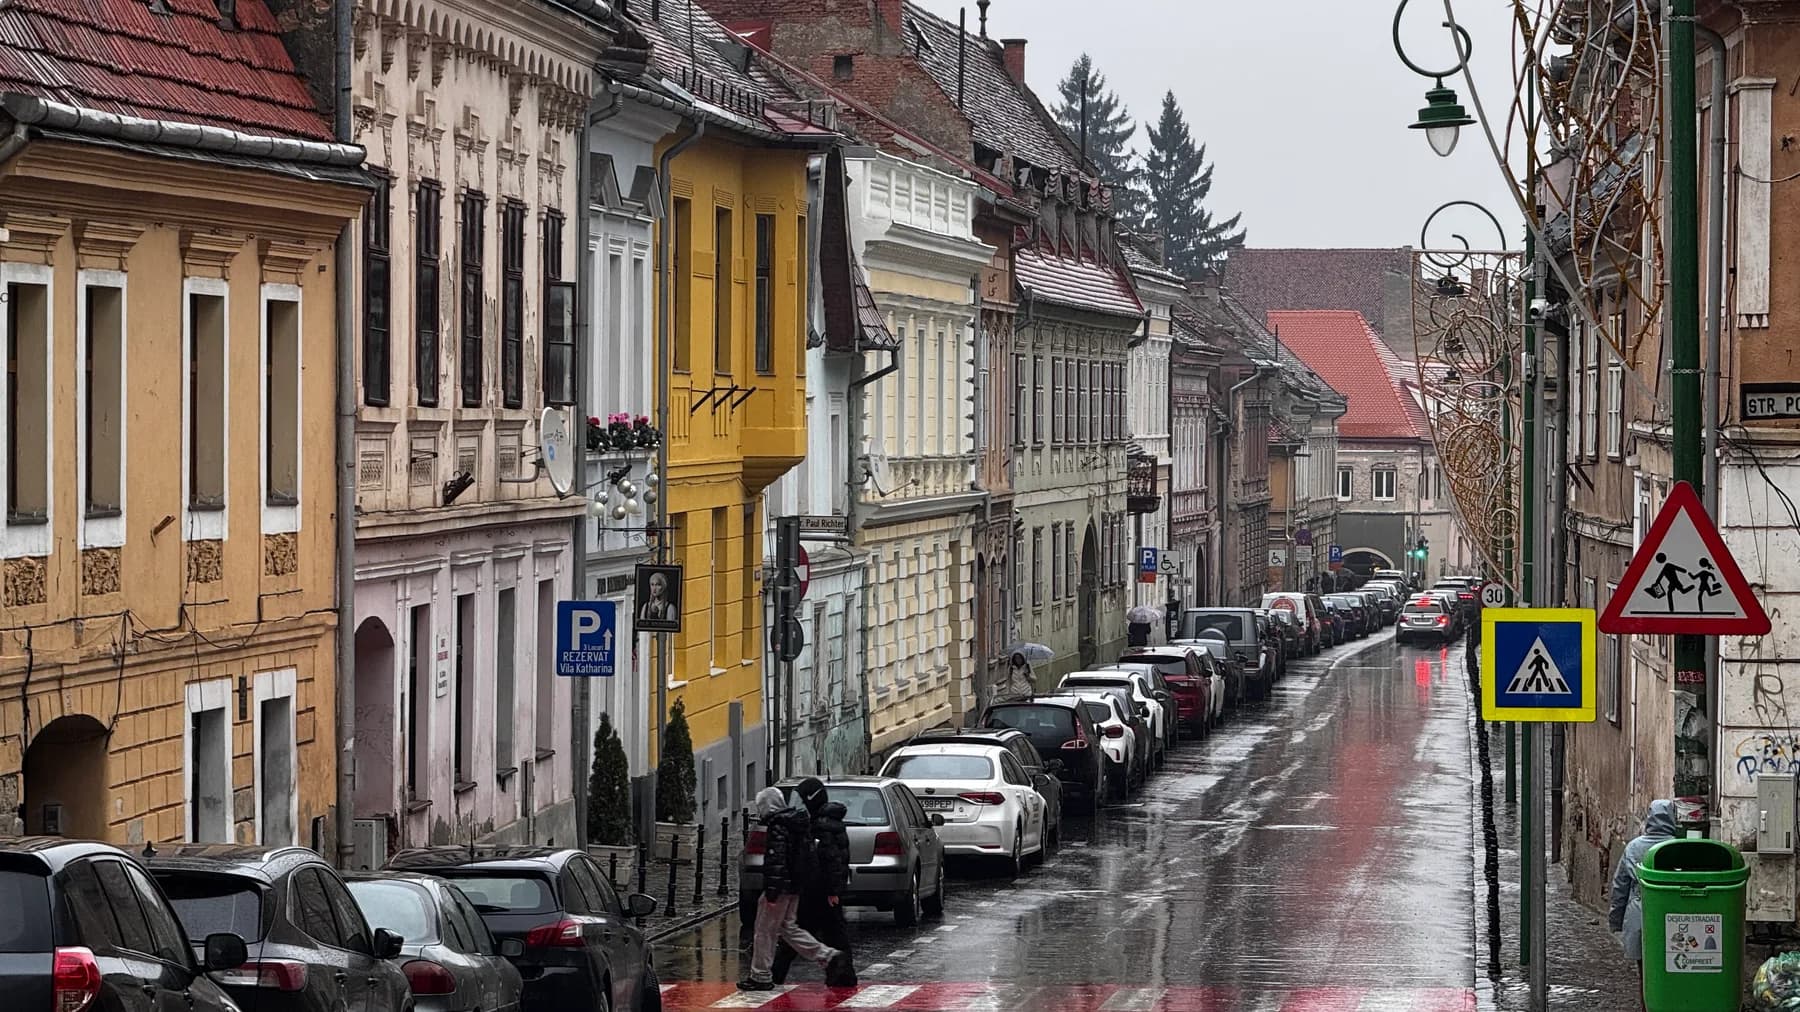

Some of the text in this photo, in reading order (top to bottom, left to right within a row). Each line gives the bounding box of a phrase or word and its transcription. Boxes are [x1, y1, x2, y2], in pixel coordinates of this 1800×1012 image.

[1749, 397, 1778, 413] STR.
[806, 518, 820, 528] Paul
[821, 518, 844, 528] Richter
[1143, 550, 1153, 564] P
[1486, 588, 1503, 603] 30
[571, 609, 601, 651] P
[563, 651, 609, 662] REZERVAT
[560, 662, 613, 673] Vila Katharina
